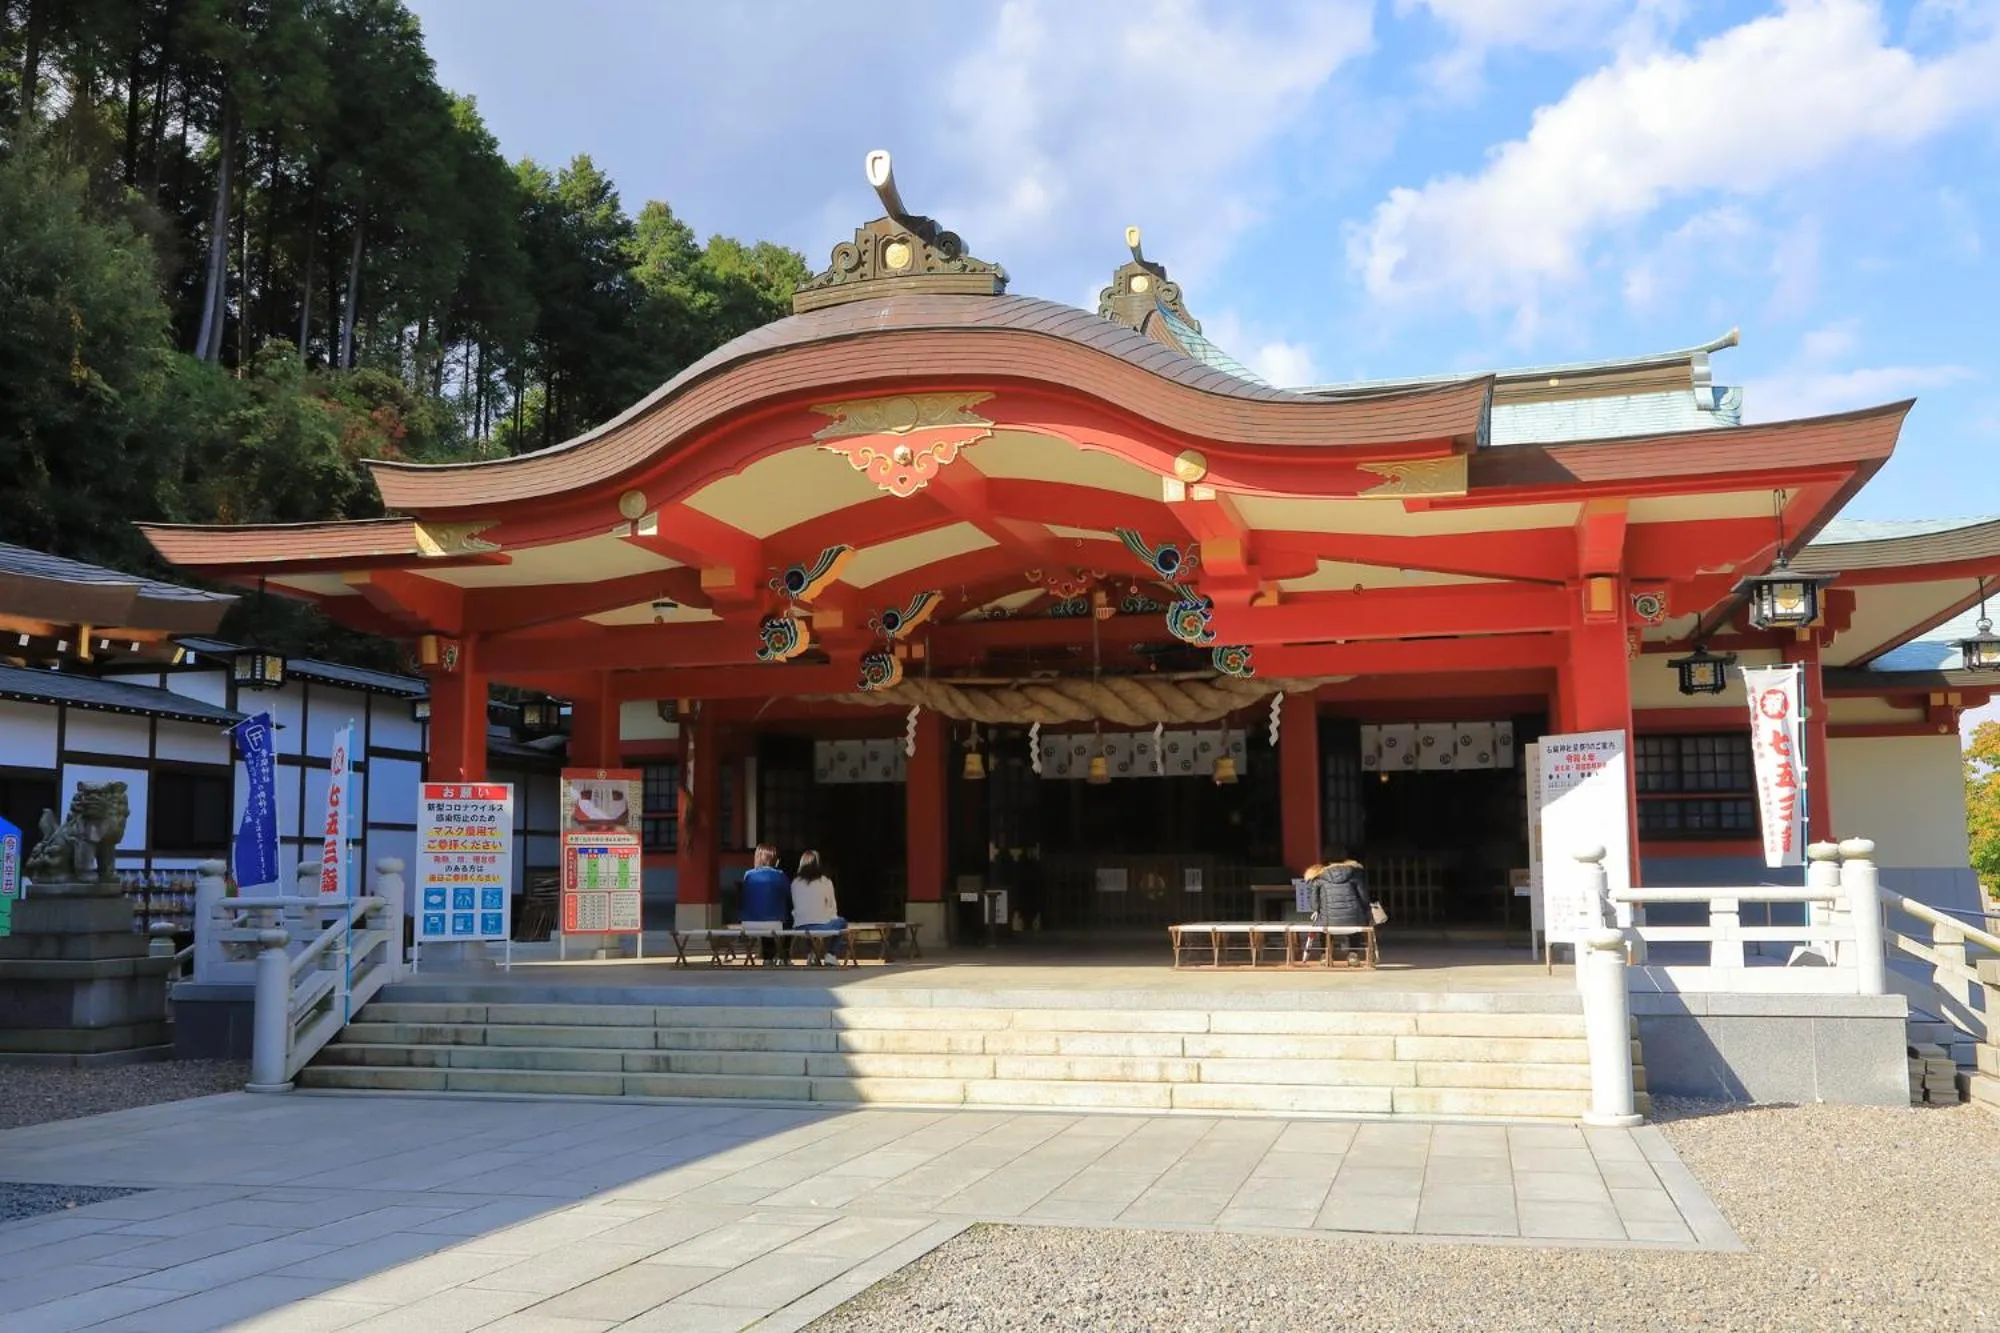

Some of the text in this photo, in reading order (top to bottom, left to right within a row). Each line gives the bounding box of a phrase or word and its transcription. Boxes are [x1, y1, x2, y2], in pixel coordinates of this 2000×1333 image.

[443, 787, 489, 799] お願い
[427, 803, 504, 812] 新型コロナウイルス
[436, 814, 496, 823] 感染防止のため
[427, 840, 502, 850] ご参拝ください
[445, 865, 484, 873] のある方は
